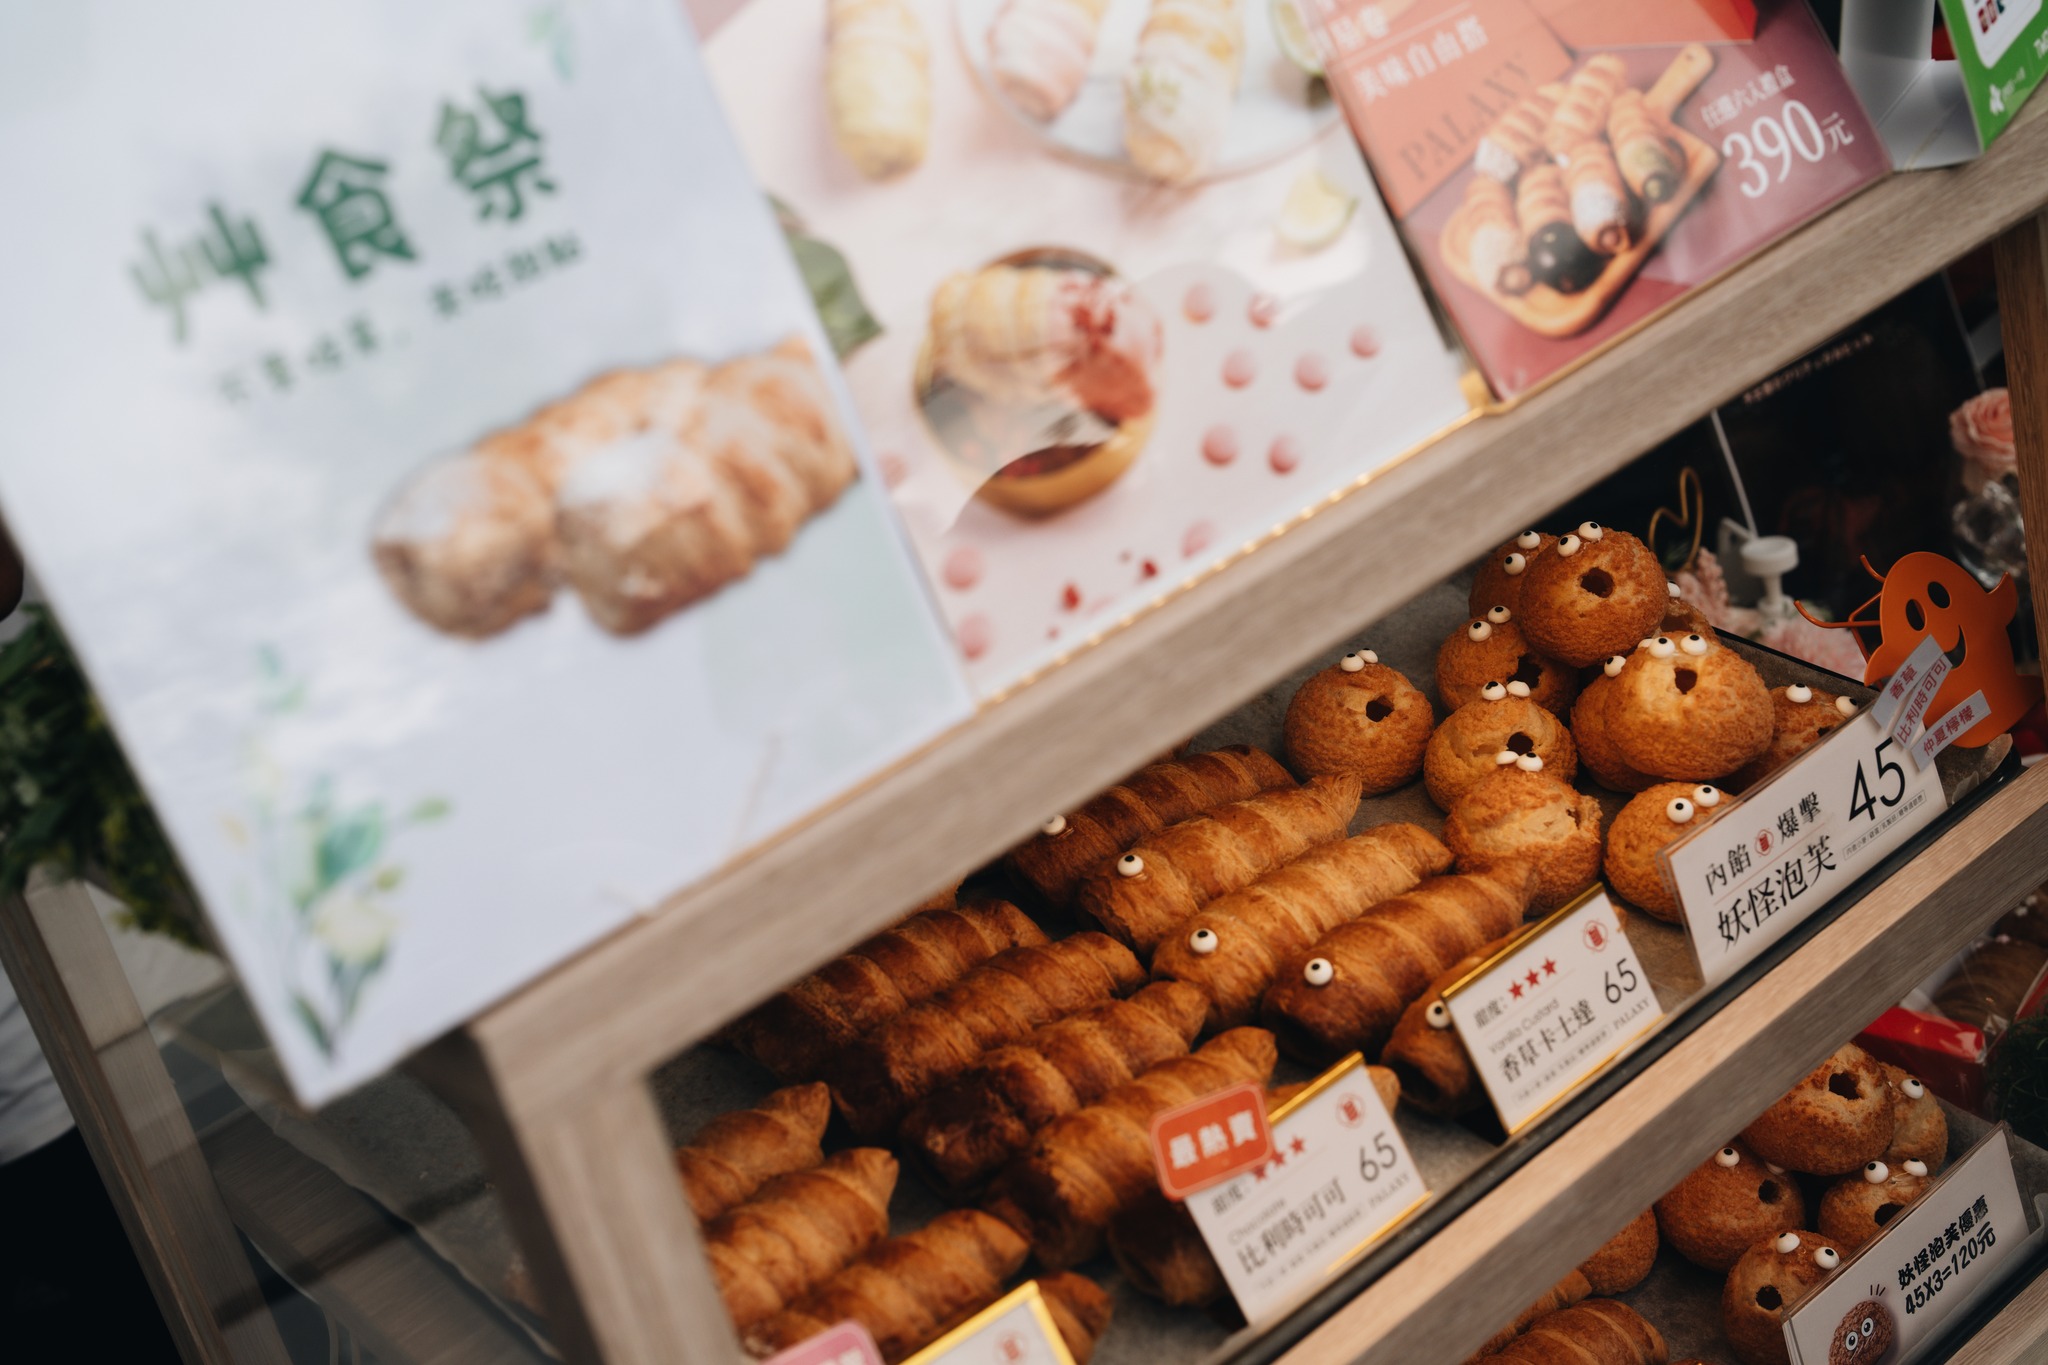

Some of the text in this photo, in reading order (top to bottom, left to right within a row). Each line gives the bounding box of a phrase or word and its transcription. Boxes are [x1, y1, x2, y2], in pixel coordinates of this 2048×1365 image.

[1889, 663, 1918, 700] 香草
[1897, 658, 1947, 744] 比利時可可
[1923, 704, 1975, 756] 仲夏檸檬
[1849, 736, 1906, 822] 45
[1717, 835, 1837, 953] 妖怪泡芙
[1605, 957, 1637, 1004] 65
[1501, 999, 1596, 1083] 香草卡士達
[1359, 1130, 1397, 1183] 65
[1236, 1176, 1347, 1275] 比利時可可
[1898, 1194, 1988, 1291] 妖怪泡芙優惠
